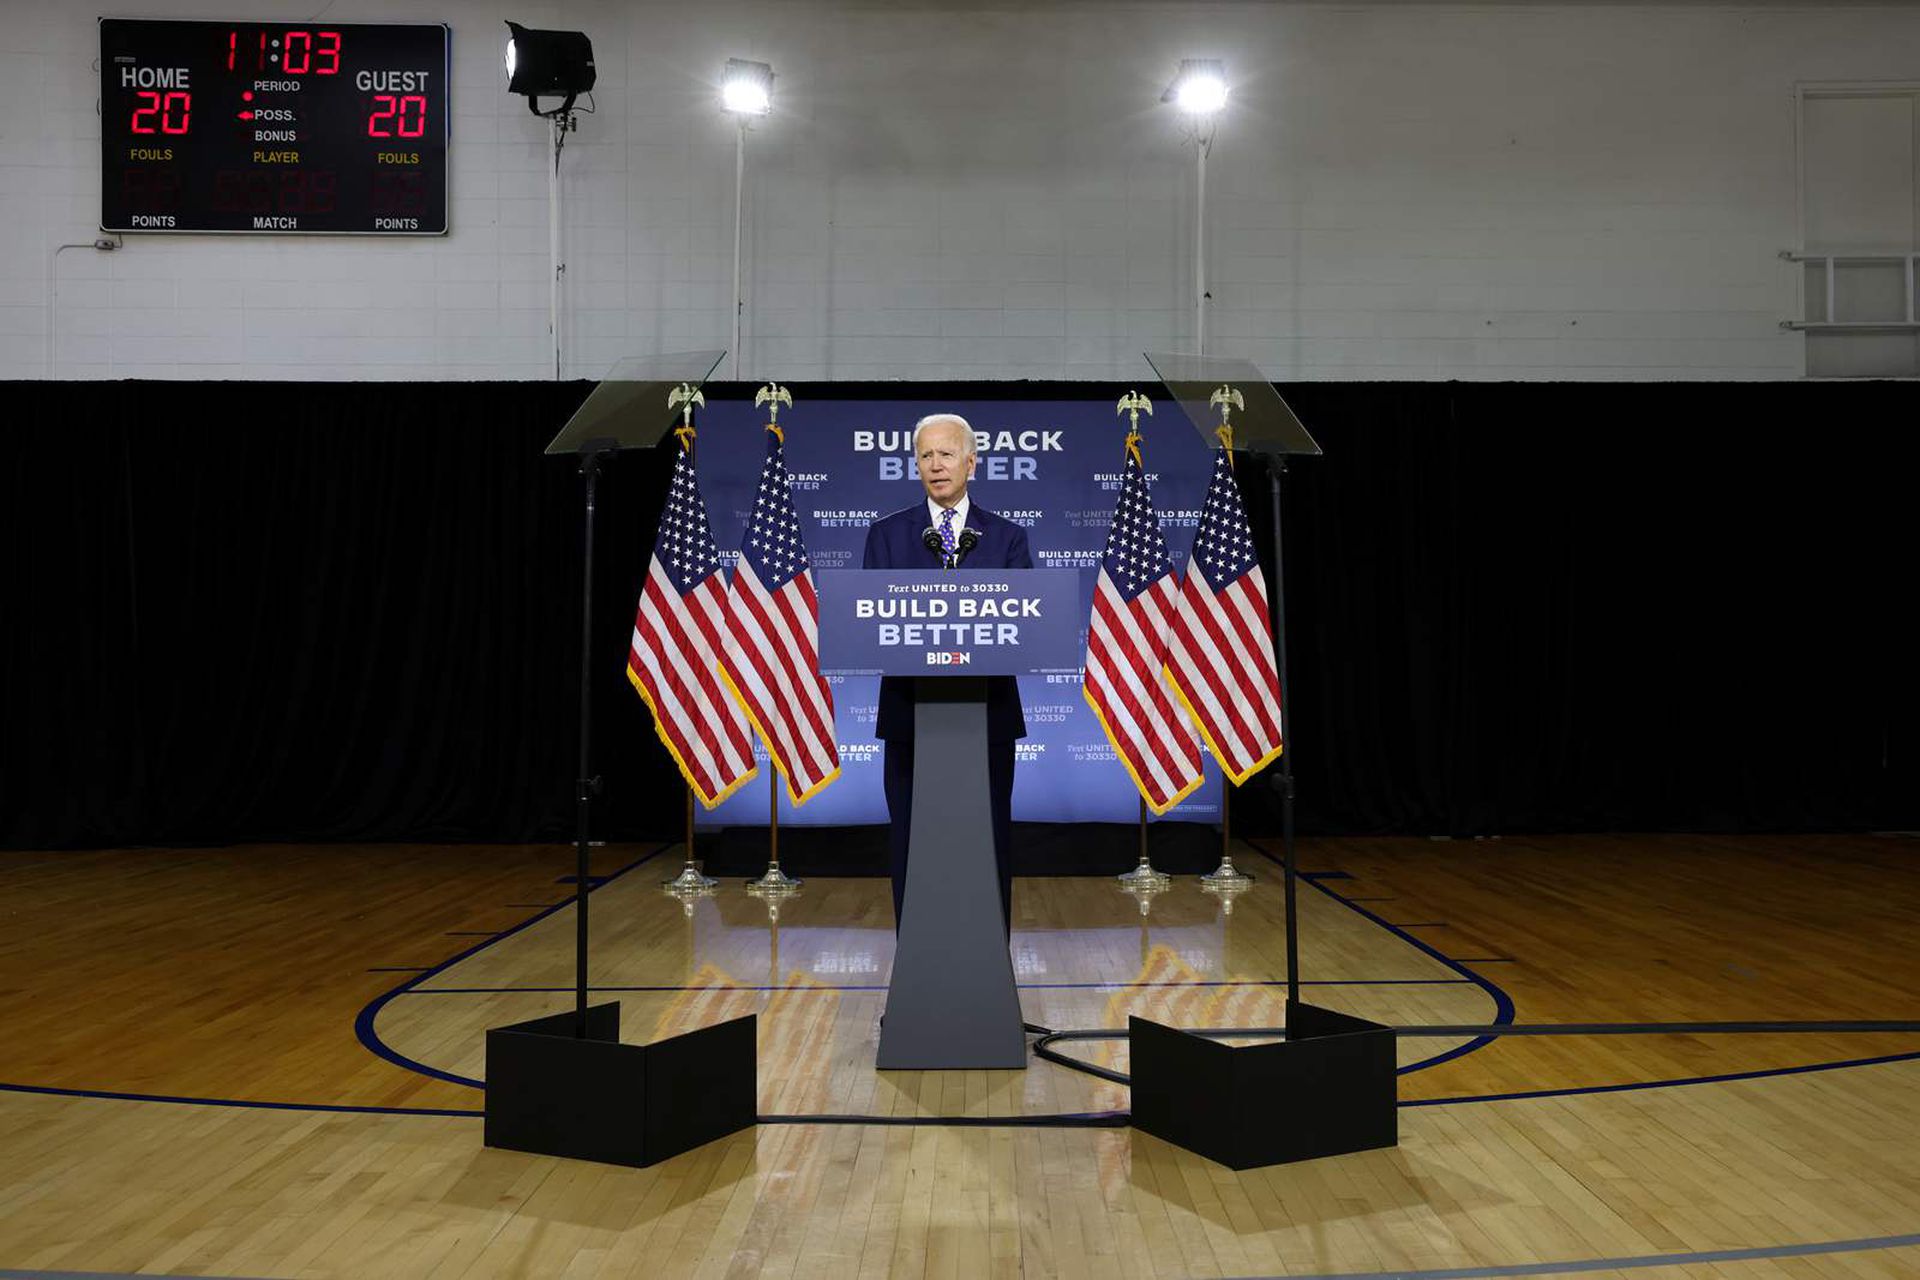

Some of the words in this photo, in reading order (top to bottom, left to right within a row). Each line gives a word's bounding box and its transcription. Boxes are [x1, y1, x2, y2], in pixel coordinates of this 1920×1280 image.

[228, 31, 341, 74] 11:03
[122, 67, 190, 88] HOME
[356, 71, 429, 92] GUEST
[254, 81, 301, 92] PERIOD
[131, 92, 191, 134] 20
[254, 110, 297, 121] POSS.
[368, 96, 426, 137] 20
[255, 130, 297, 141] BONUS
[130, 149, 173, 161] FOULS
[253, 151, 299, 164] PLAYER
[377, 153, 420, 164] FOULS
[132, 215, 175, 228] POINTS
[253, 217, 297, 229] MATCH
[375, 218, 418, 230] POINTS
[854, 431, 911, 451] BUI
[974, 431, 1063, 451] BACK
[813, 510, 846, 518] BUILD
[849, 510, 878, 518] BACK
[821, 519, 870, 527] BETTER
[1159, 519, 1199, 527] ETTER
[1046, 559, 1095, 567] BETTER
[888, 584, 909, 593] Text
[912, 584, 957, 592] UNITED
[960, 584, 970, 593] to
[972, 584, 1009, 592] 30330
[856, 599, 949, 618] BUILD
[959, 598, 1041, 617] BACK
[879, 624, 1020, 646] BETTER
[927, 652, 970, 665] BIDEN
[850, 744, 879, 752] BACK
[1015, 744, 1045, 752] BACK
[839, 753, 871, 761] TTER
